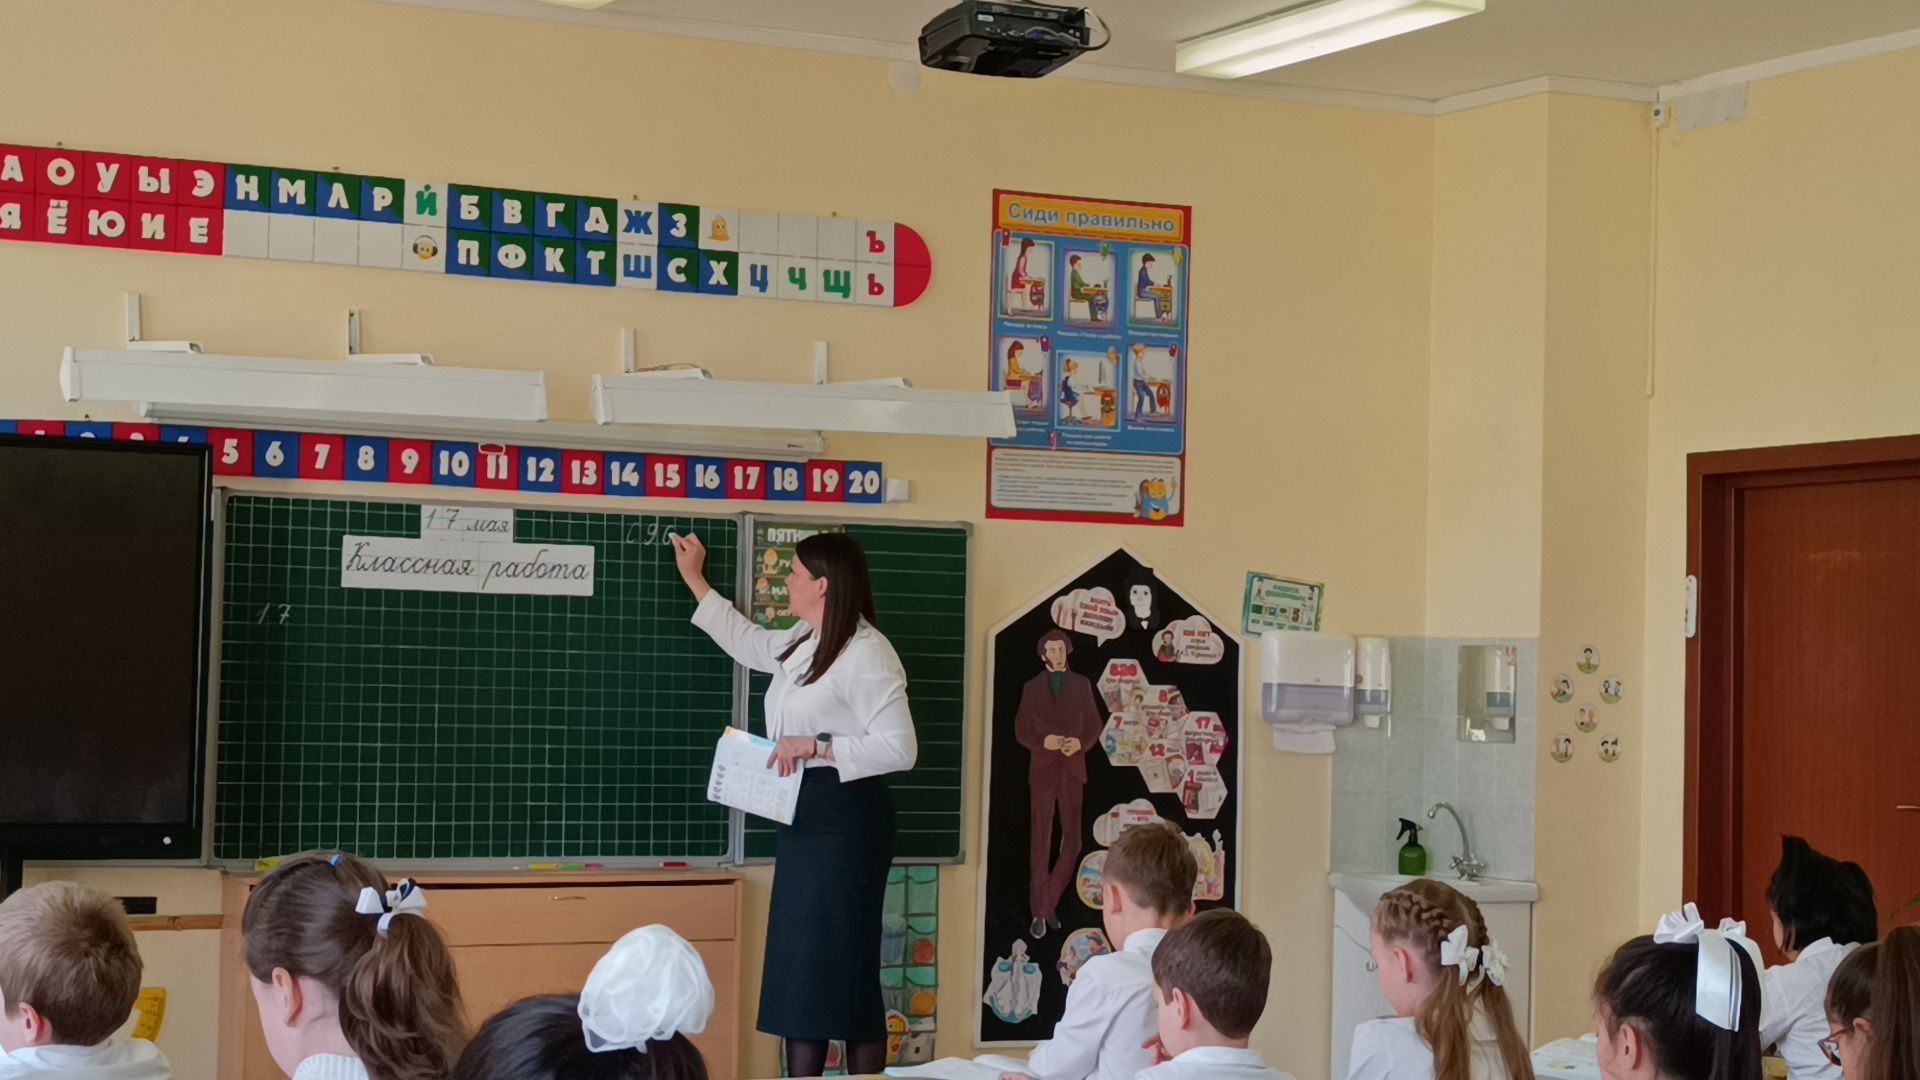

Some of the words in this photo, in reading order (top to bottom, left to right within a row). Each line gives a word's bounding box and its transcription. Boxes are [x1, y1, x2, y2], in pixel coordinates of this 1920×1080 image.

[1, 155, 24, 183] А
[46, 158, 74, 186] О
[96, 163, 120, 193] У
[137, 165, 171, 194] Ы
[191, 169, 215, 198] Э
[235, 174, 260, 202] Н
[277, 177, 307, 205] М
[327, 182, 350, 209] Л
[372, 186, 393, 212] Р
[416, 184, 438, 217] Й
[459, 194, 480, 221] Б
[502, 198, 522, 225] В
[545, 202, 566, 228] Г
[584, 206, 609, 234] Д
[623, 211, 652, 235] Ж
[669, 212, 687, 238] З
[866, 230, 887, 255] Ъ
[1008, 201, 1059, 225] Сиди
[1065, 205, 1175, 235] правильно
[0, 202, 22, 230] Я
[47, 199, 69, 235] Ё
[87, 209, 125, 238] Ю
[141, 212, 166, 240] И
[188, 217, 210, 244] Е
[457, 239, 480, 266] П
[497, 243, 527, 269] Ф
[544, 247, 565, 273] К
[586, 250, 606, 276] Т
[623, 256, 652, 279] Ш
[666, 257, 688, 283] С
[708, 260, 729, 286] Х
[751, 267, 768, 292] Ц
[789, 268, 807, 291] Ч
[824, 271, 851, 299] Щ
[867, 273, 885, 297] Ь
[221, 439, 239, 464] 5
[265, 442, 284, 467] 6
[314, 443, 330, 469] 7
[357, 446, 375, 471] 8
[401, 448, 419, 474] 9
[439, 450, 470, 477] 10
[486, 453, 509, 479] 11
[526, 457, 555, 483] 12
[571, 460, 597, 486] 13
[610, 462, 640, 487] 14
[654, 462, 681, 488] 15
[695, 464, 721, 490] 16
[733, 466, 760, 490] 17
[773, 467, 799, 492] 18
[812, 468, 839, 493] 19
[848, 470, 880, 495] 20
[466, 517, 511, 533] мая
[346, 541, 476, 576] Классная
[481, 548, 590, 590] работа
